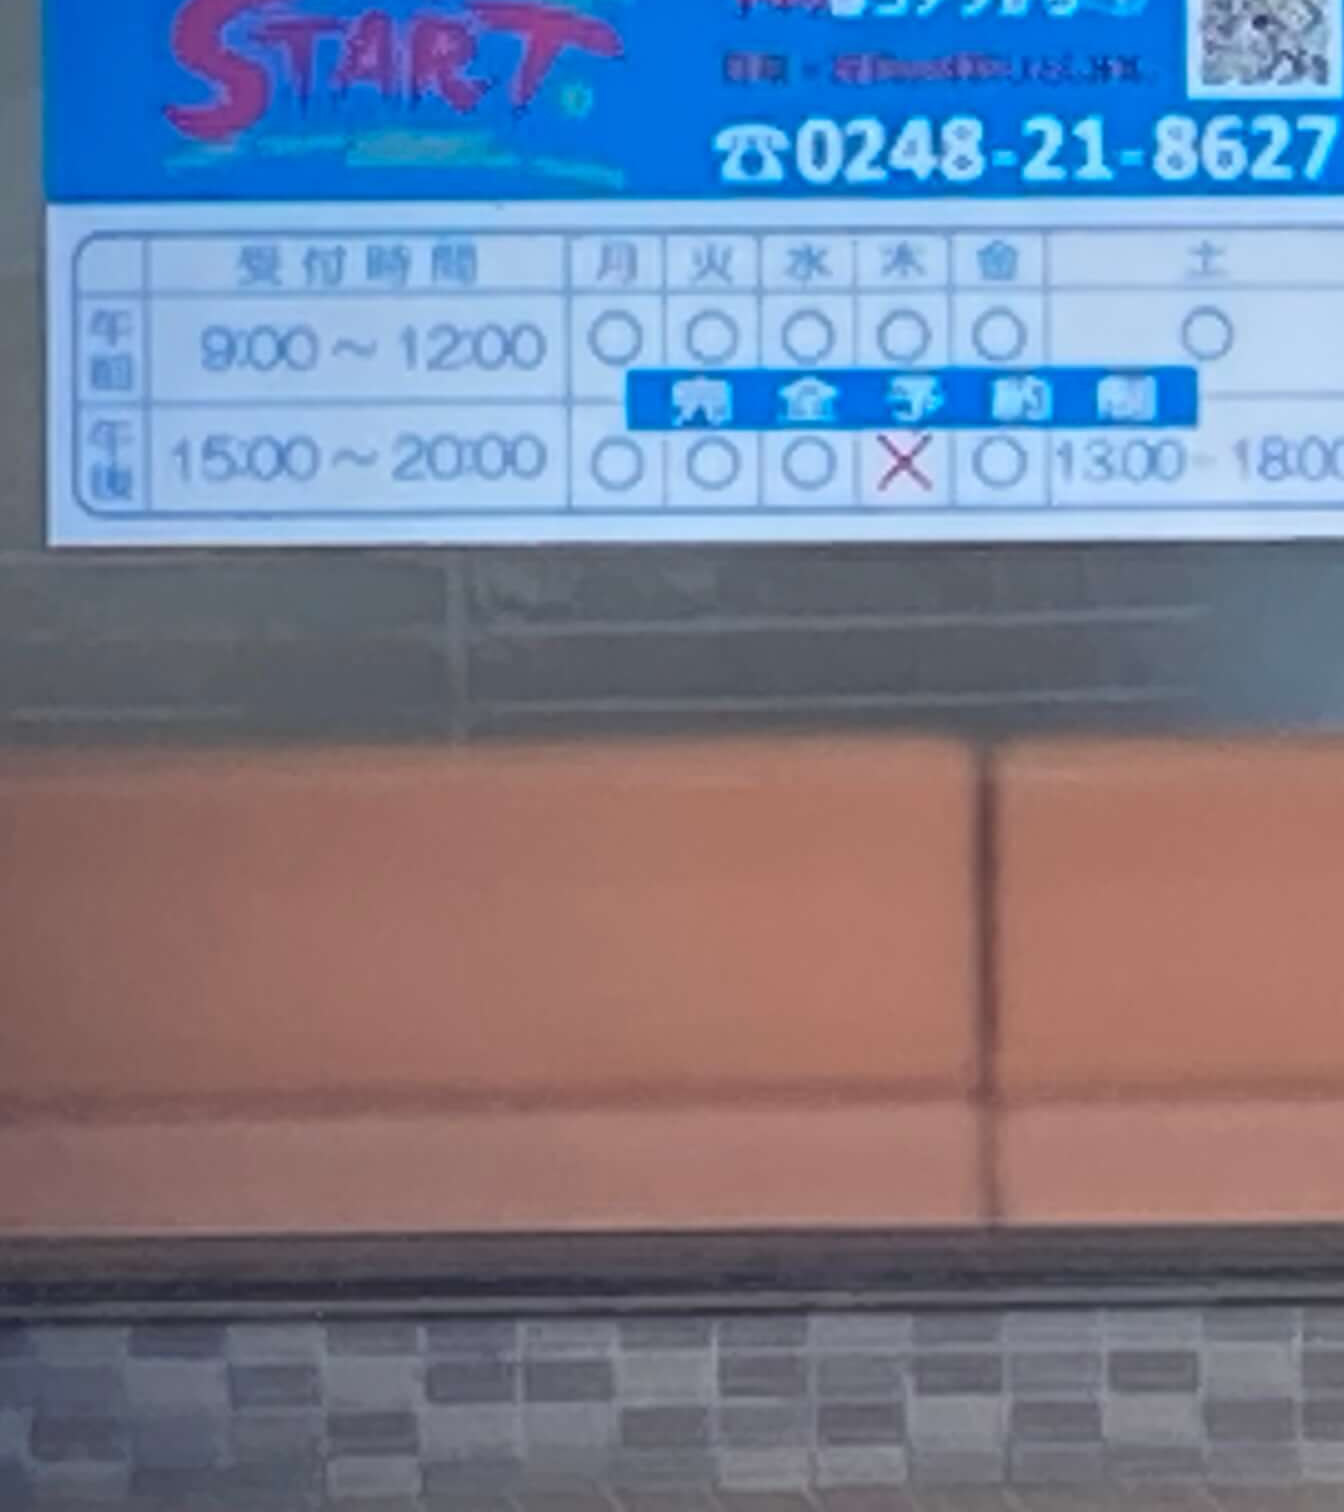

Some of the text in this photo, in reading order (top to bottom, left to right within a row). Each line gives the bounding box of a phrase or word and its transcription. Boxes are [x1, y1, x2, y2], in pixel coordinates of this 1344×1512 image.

[795, 114, 1340, 182] 0248-21-8627
[690, 242, 733, 283] 火
[786, 242, 832, 283] 水
[880, 240, 926, 278] 木
[1185, 240, 1229, 276] 土
